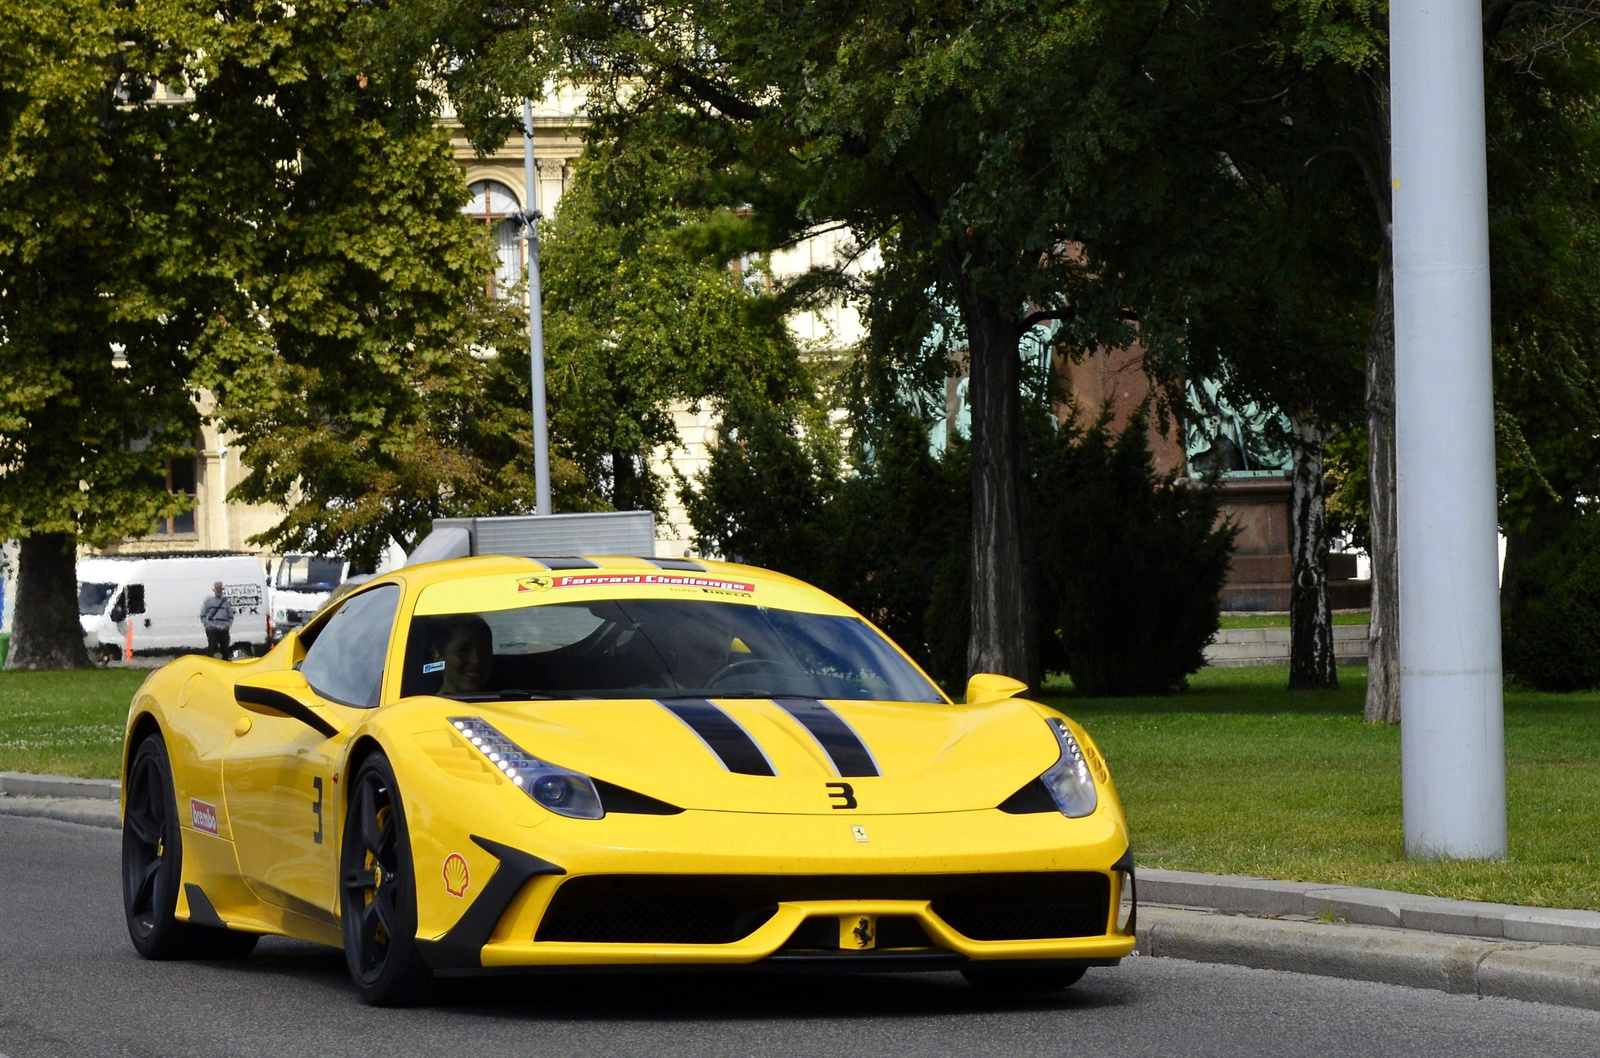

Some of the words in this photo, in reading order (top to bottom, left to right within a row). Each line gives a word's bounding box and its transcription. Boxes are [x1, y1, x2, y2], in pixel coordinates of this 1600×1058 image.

[561, 576, 641, 586] Ferrari
[645, 575, 746, 590] Challenge
[825, 782, 858, 809] 3
[192, 803, 217, 830] brembo
[313, 776, 323, 845] 3
